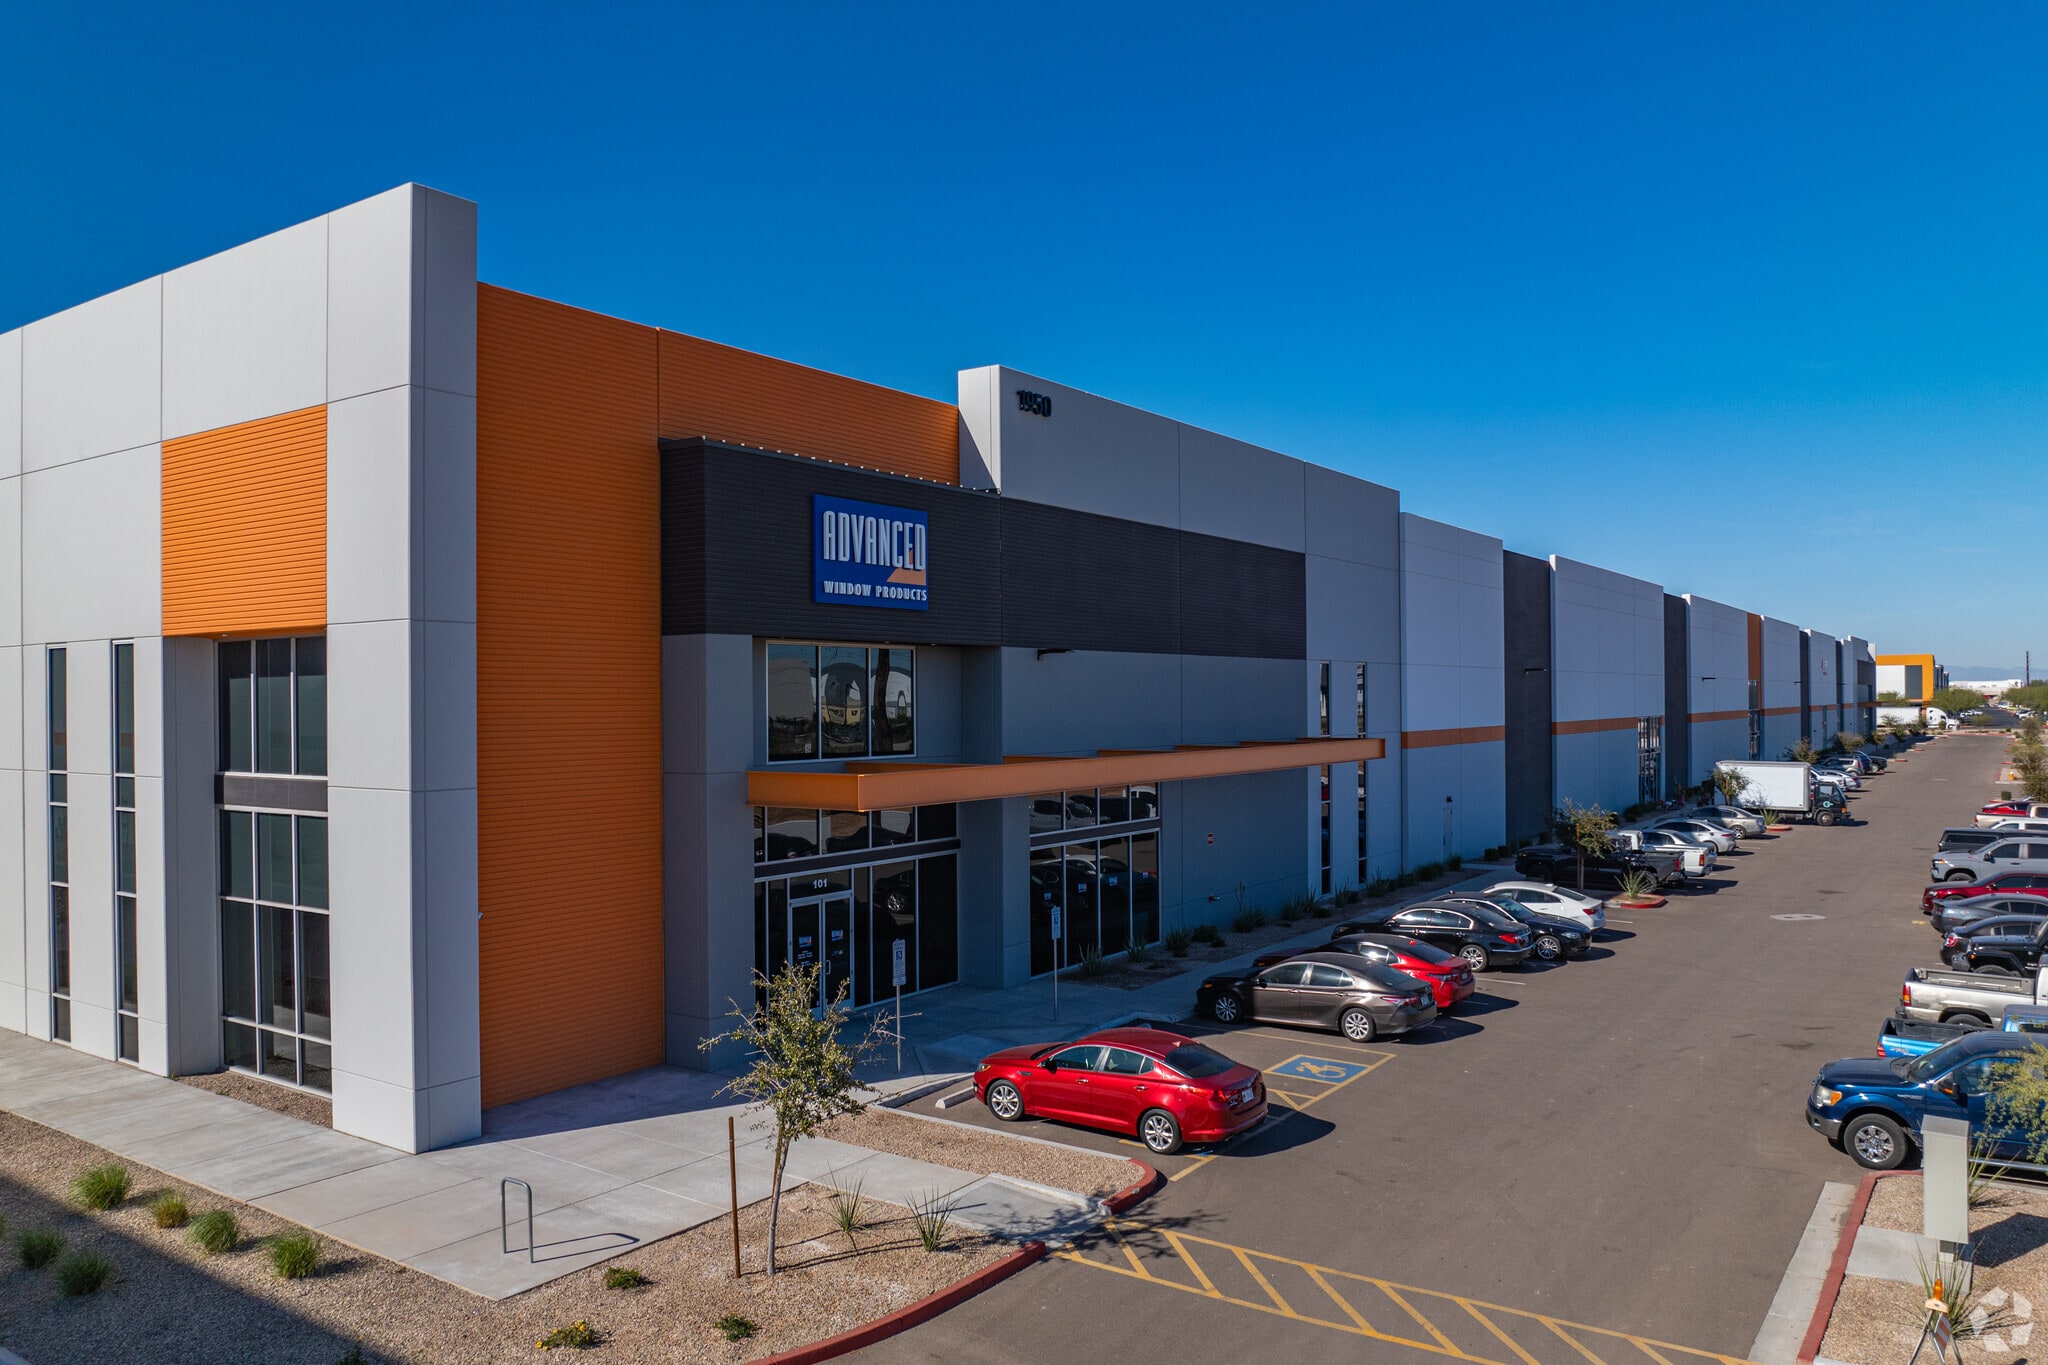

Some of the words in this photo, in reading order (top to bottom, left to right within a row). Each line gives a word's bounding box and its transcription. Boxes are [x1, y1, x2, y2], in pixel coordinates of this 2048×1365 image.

[1016, 390, 1052, 417] 1950
[822, 510, 926, 571] ADVANCED
[823, 580, 872, 597] WINDOW
[875, 585, 928, 602] PRODUCTS
[813, 878, 828, 889] 101
